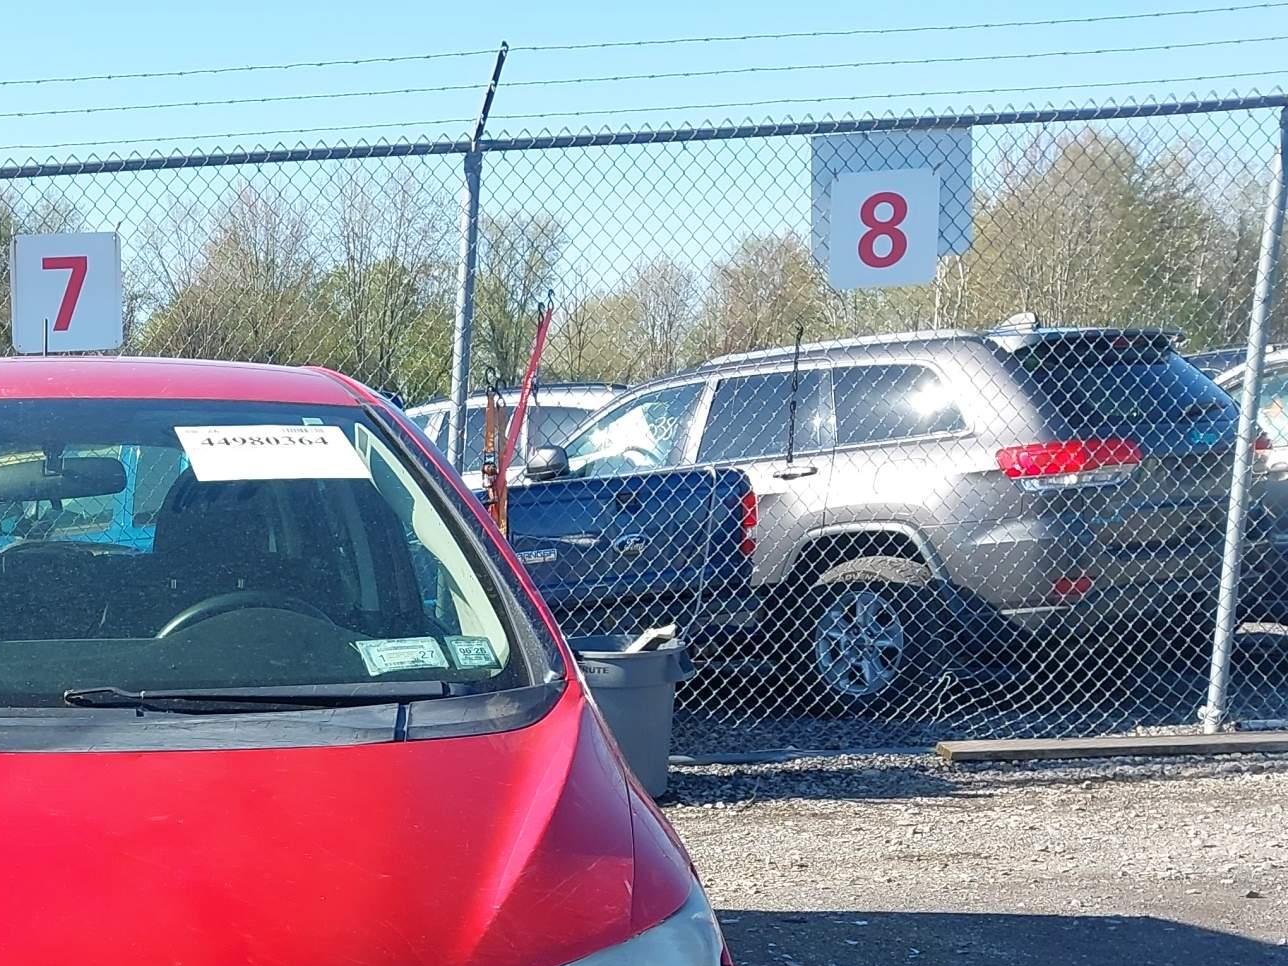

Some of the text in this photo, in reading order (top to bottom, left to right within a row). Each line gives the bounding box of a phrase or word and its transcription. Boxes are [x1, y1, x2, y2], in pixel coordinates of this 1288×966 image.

[858, 192, 907, 268] 8
[42, 256, 87, 331] 7
[201, 436, 329, 446] 44980364
[419, 651, 434, 659] 27
